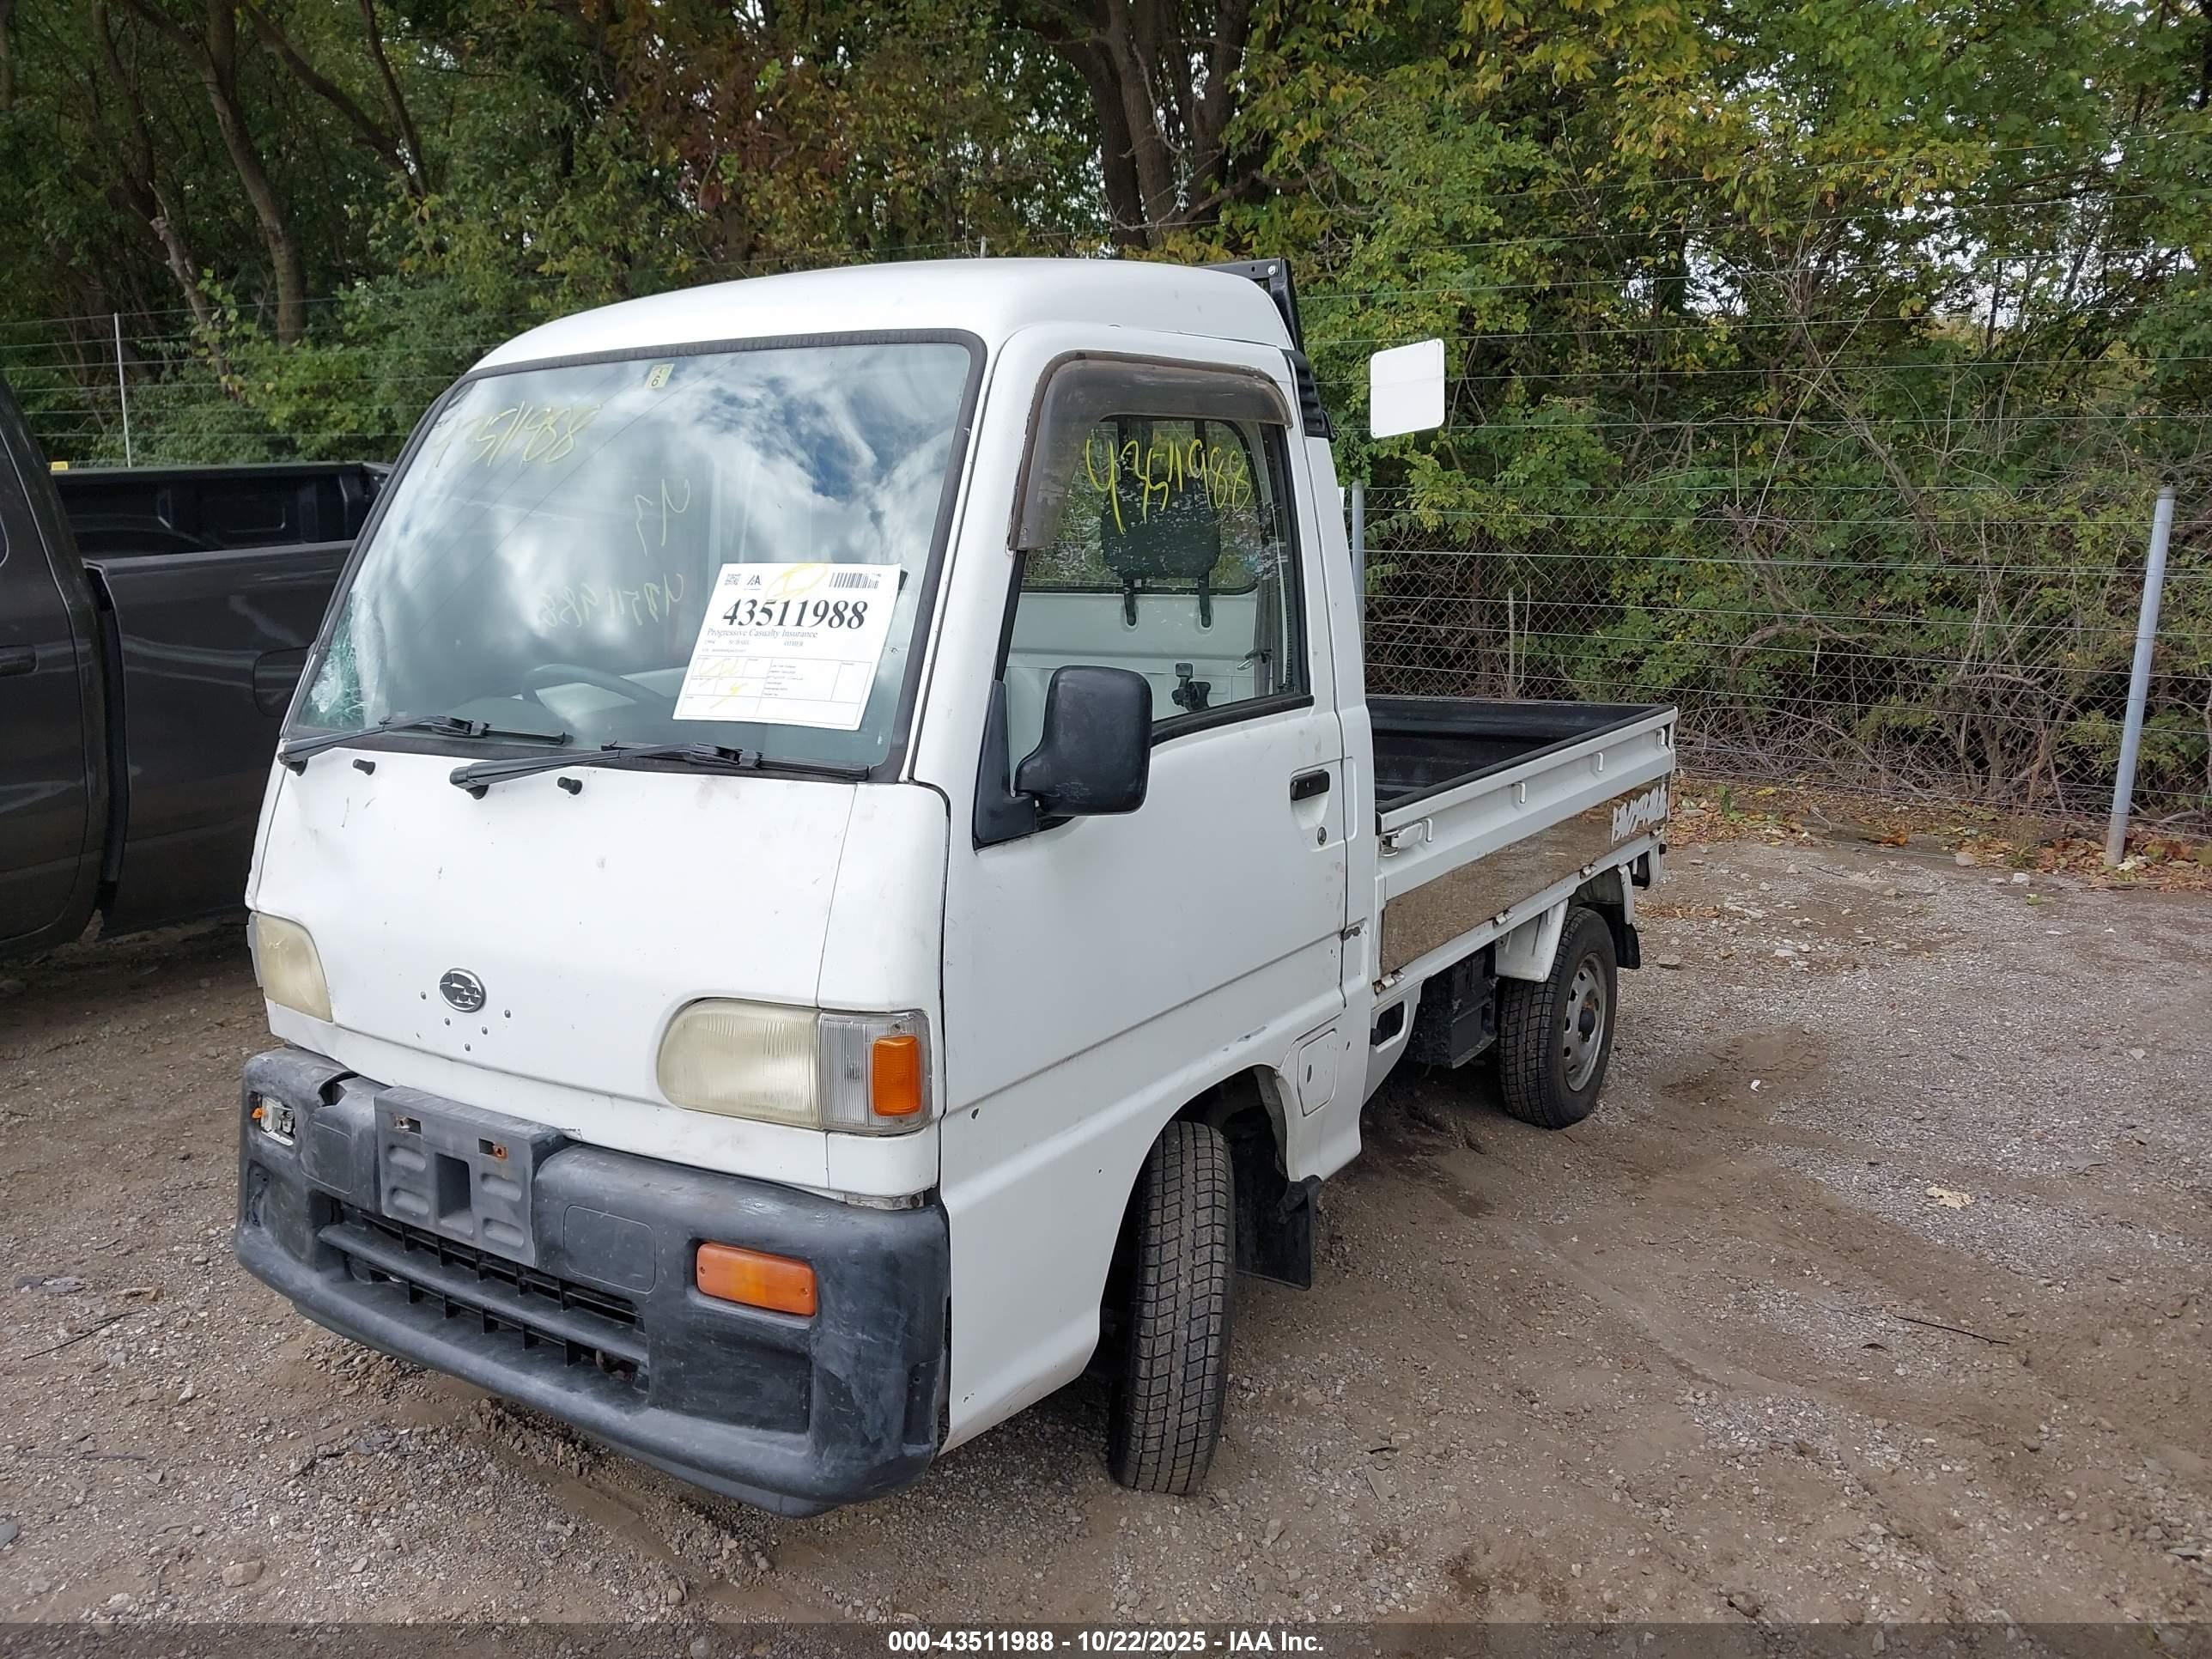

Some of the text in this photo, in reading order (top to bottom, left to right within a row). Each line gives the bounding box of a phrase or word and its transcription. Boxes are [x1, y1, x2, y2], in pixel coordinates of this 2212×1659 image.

[722, 599, 868, 629] 43511988
[707, 628, 818, 639] Progressive Casualty Insurance
